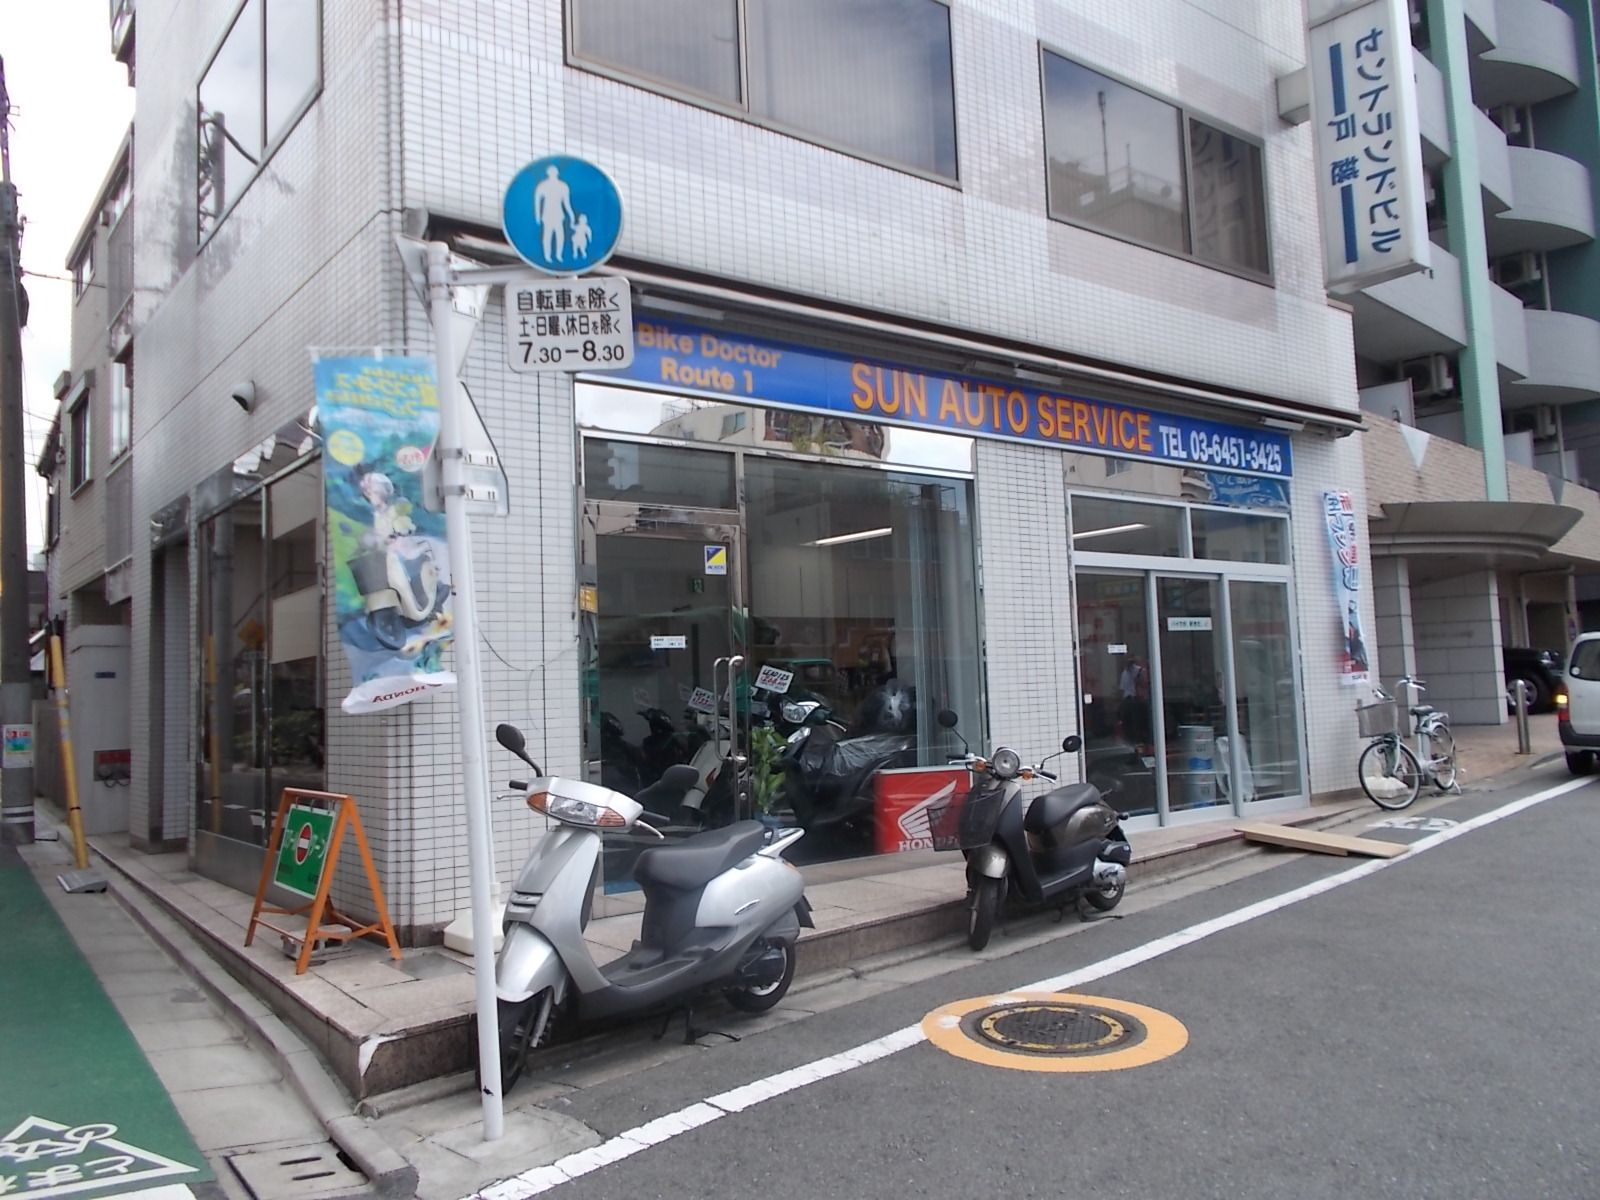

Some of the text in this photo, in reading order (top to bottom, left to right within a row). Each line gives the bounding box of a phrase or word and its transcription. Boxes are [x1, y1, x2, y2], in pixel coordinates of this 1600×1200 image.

[1356, 28, 1401, 253] セントランドビル
[517, 288, 620, 311] 自転車を除く
[638, 323, 782, 369] Bike Doctor
[661, 359, 754, 393] Route 1
[852, 361, 1152, 452] SUN AUTO SERVICE
[1159, 426, 1283, 473] TEL 03-6451-3425
